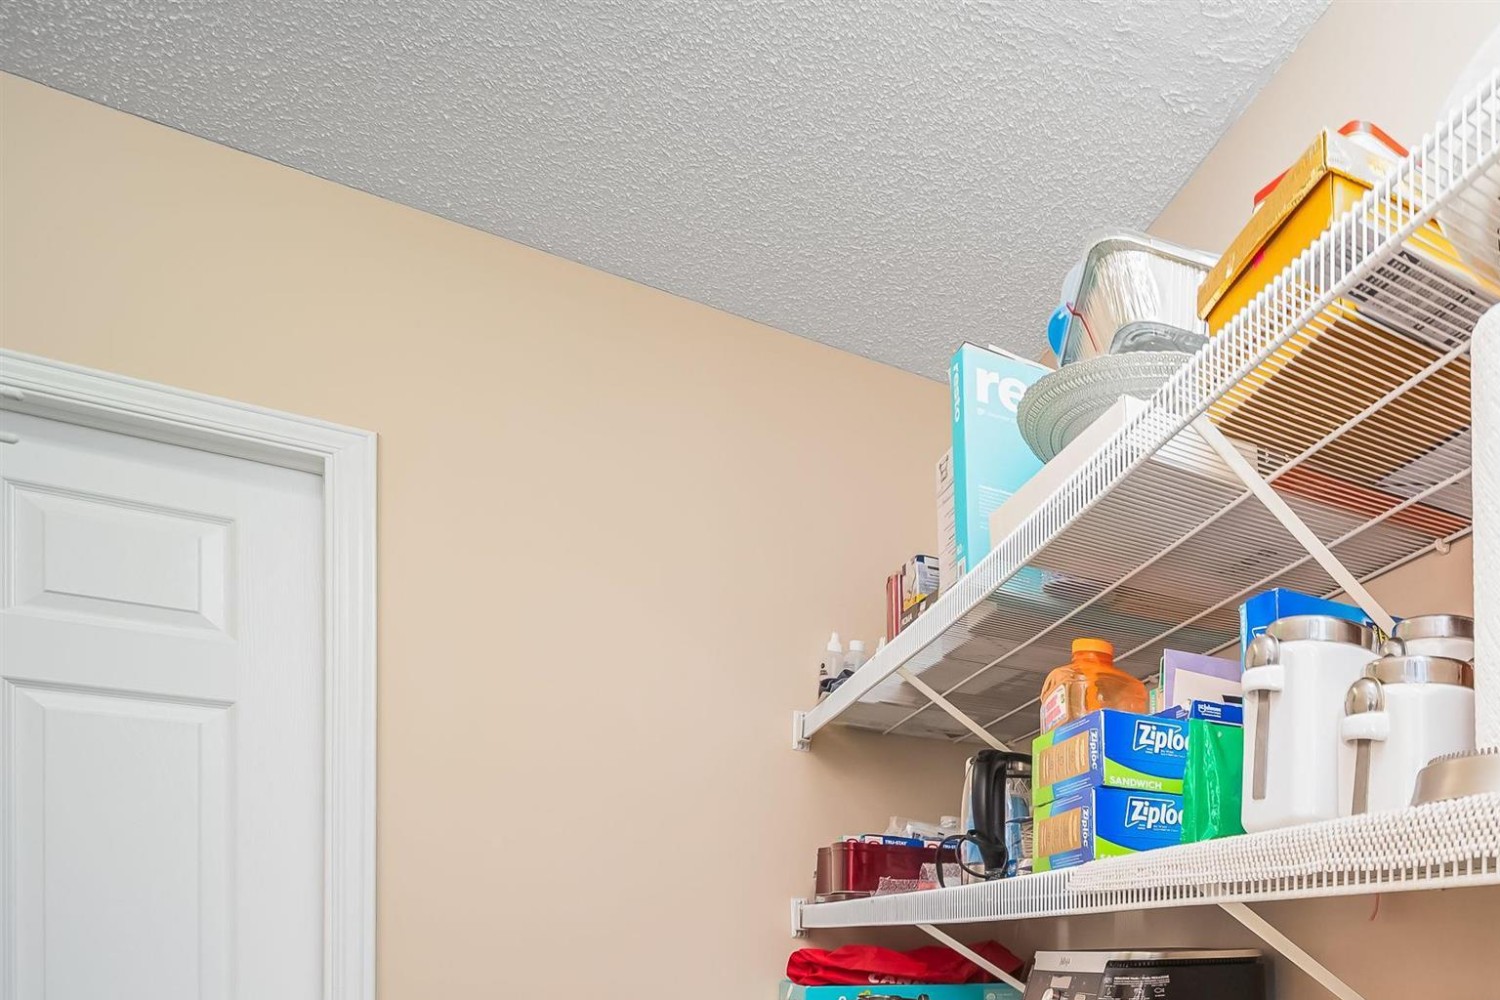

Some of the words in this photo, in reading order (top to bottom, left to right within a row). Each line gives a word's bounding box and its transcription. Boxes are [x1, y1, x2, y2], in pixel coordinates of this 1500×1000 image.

[1089, 727, 1098, 771] Ziploc
[1109, 775, 1163, 791] SANDWICH
[1081, 805, 1089, 848] Ziploc
